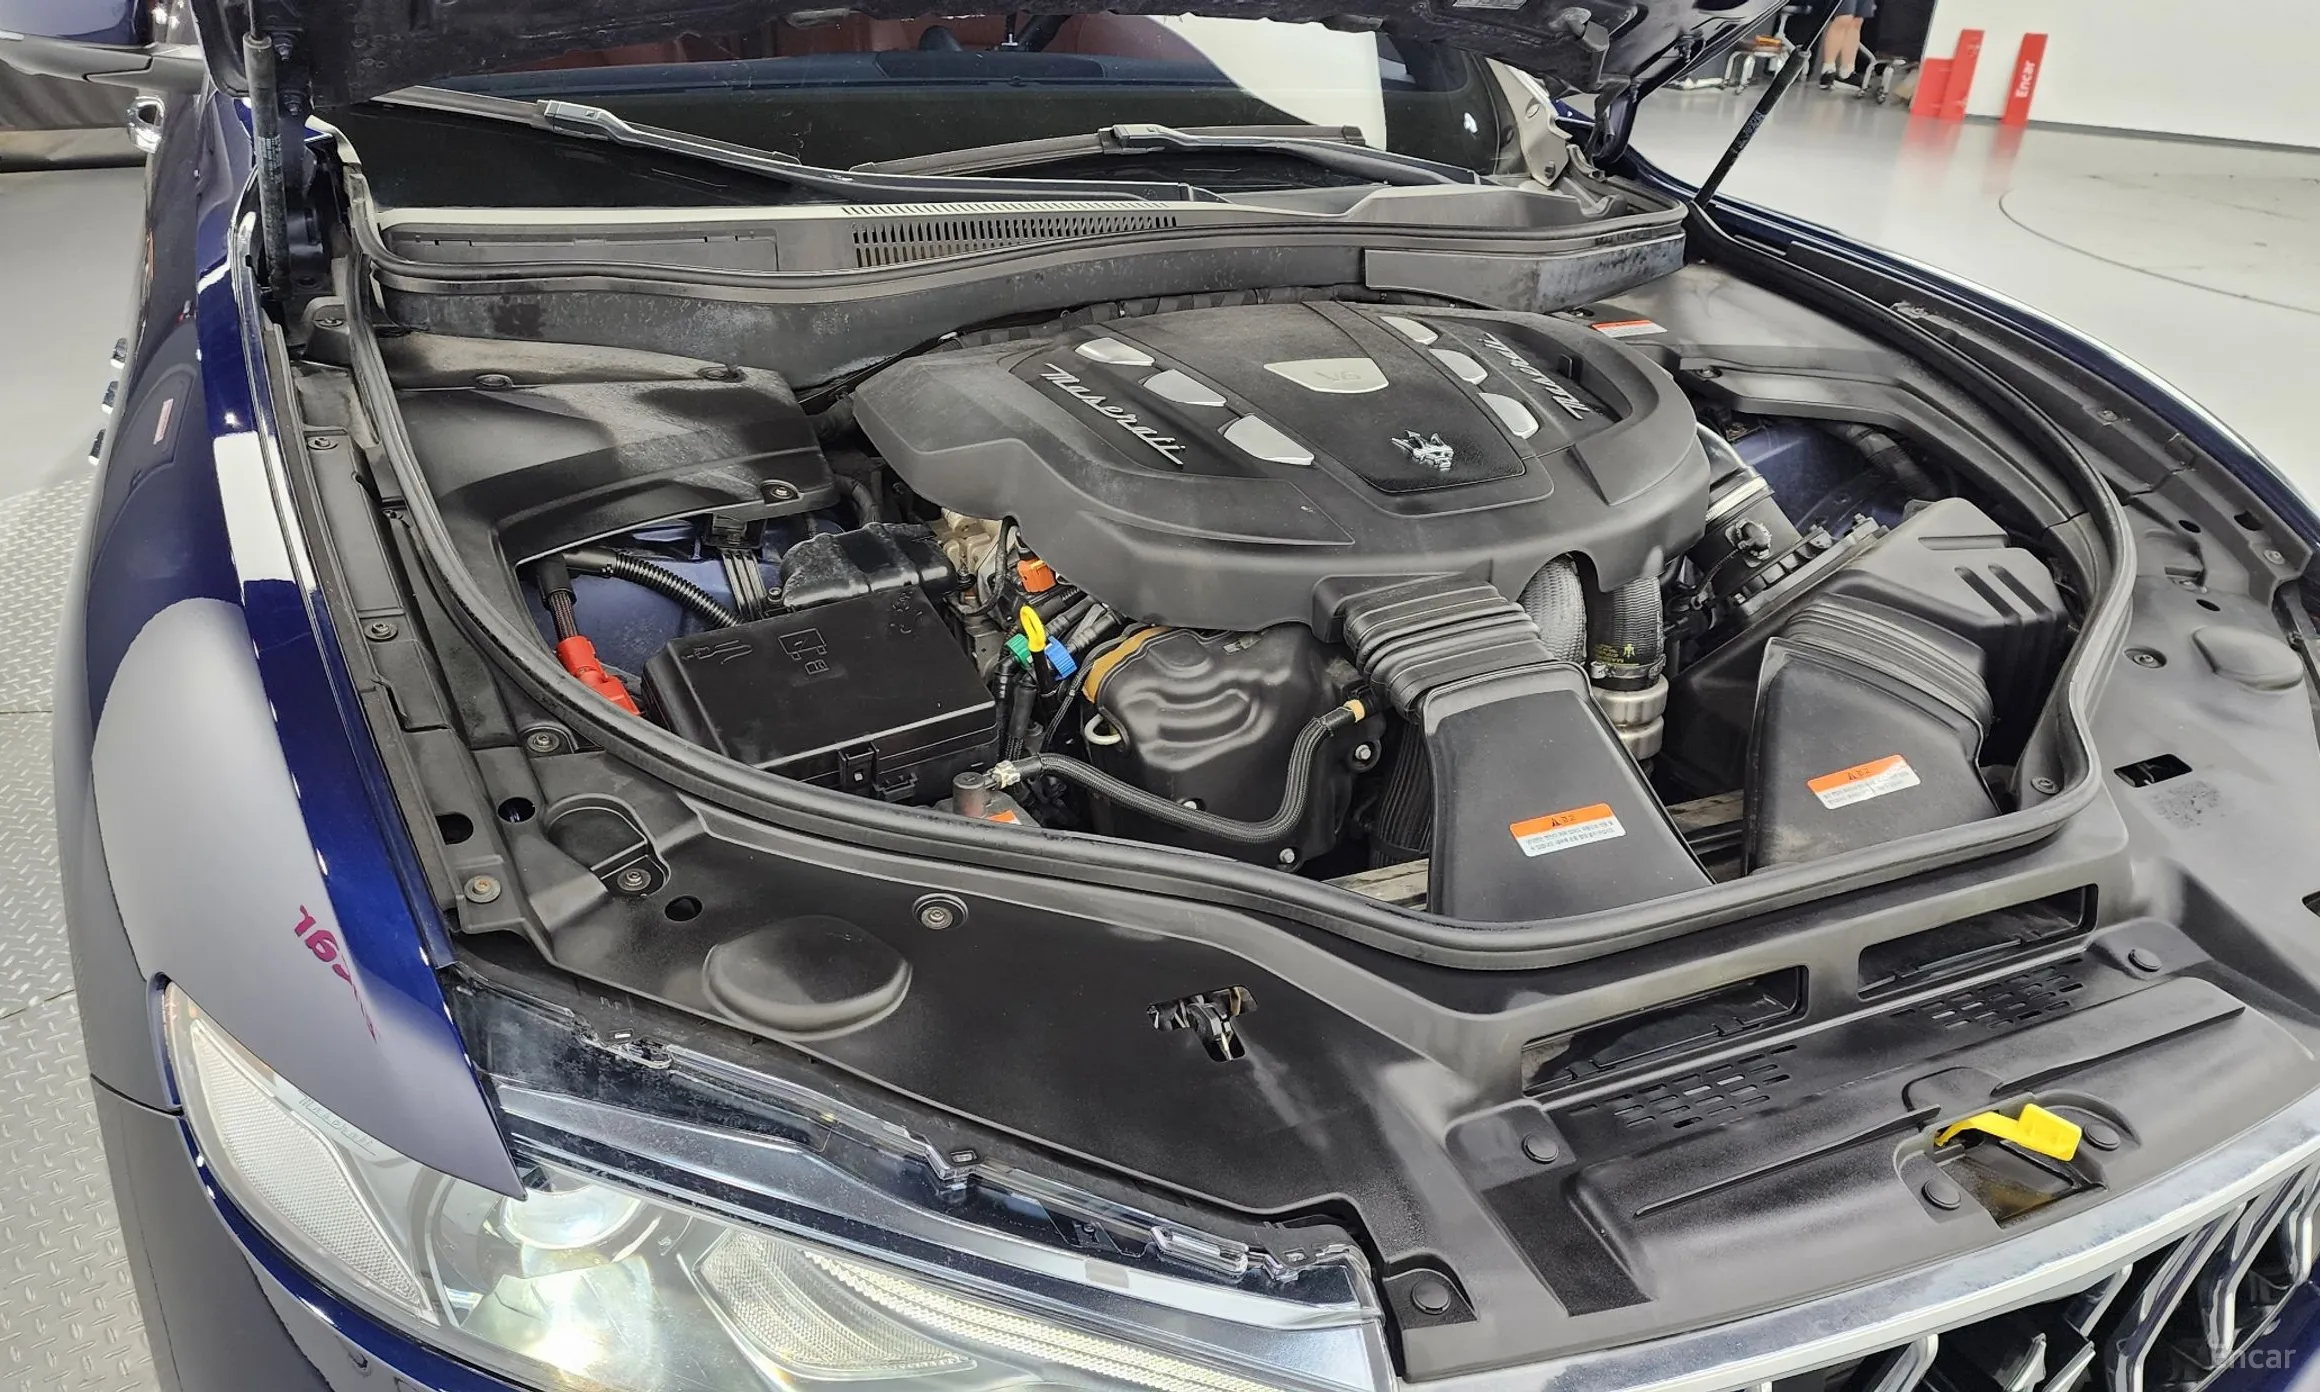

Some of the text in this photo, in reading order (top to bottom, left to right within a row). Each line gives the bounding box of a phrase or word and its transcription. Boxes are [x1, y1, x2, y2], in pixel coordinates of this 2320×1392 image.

[2015, 60, 2036, 98] Encar
[1314, 369, 1362, 383] V6
[1039, 362, 1186, 465] Maserati
